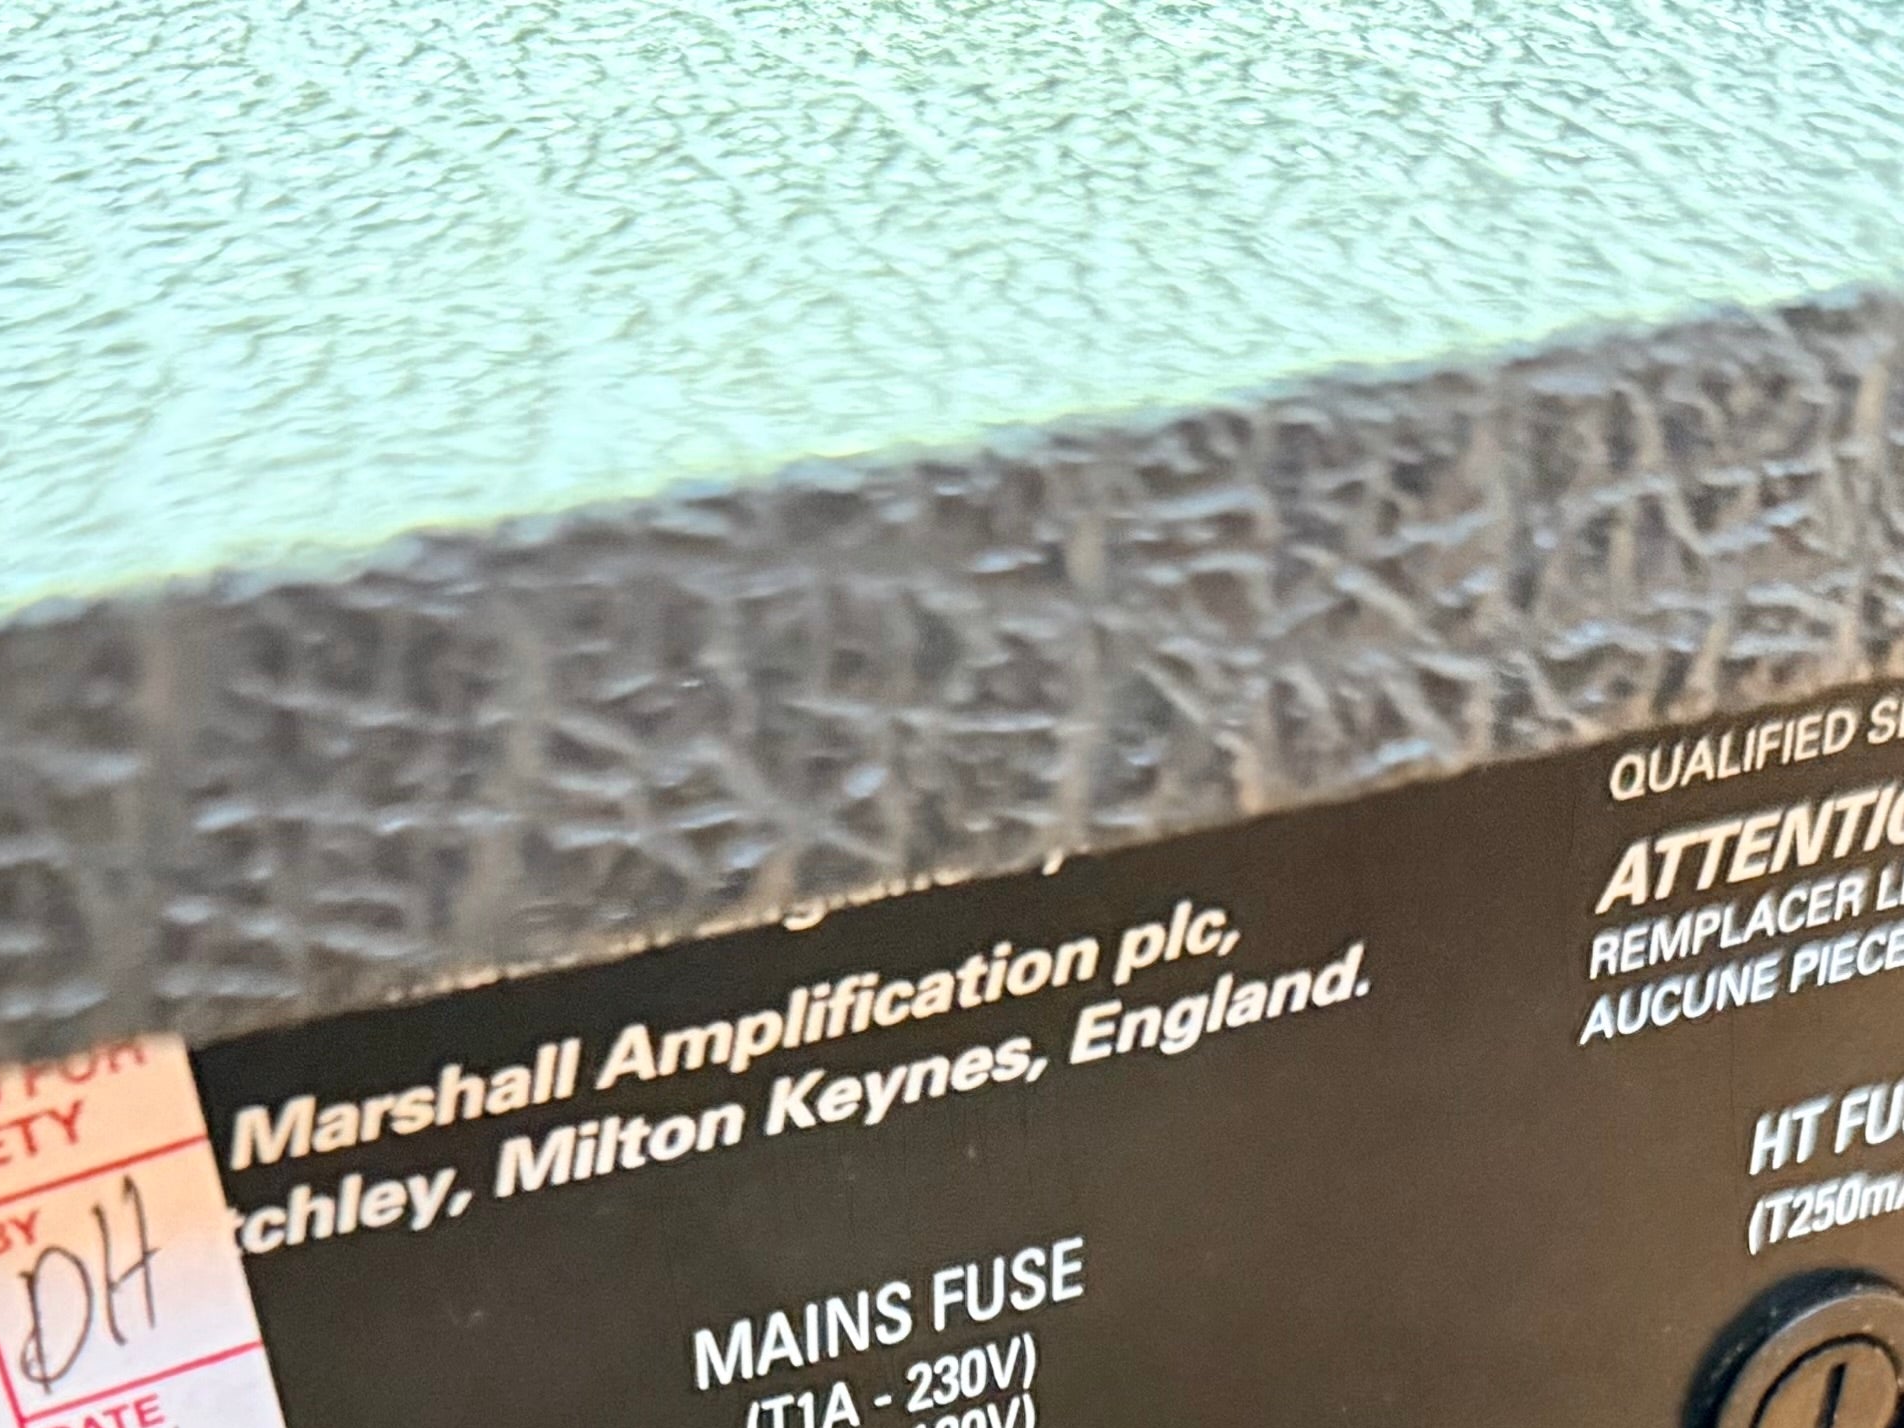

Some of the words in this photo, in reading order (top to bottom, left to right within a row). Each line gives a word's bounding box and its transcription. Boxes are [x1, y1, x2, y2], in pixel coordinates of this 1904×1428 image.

[1609, 708, 1860, 801] QUALIFIED
[1588, 869, 1871, 980] REMPLACER
[228, 1036, 584, 1173] Marshall
[593, 935, 1102, 1091] Amplification
[1111, 897, 1243, 988] plc,
[1577, 949, 1788, 1047] AUCUNE
[495, 1102, 746, 1199] Milton
[764, 1033, 1049, 1136] Keynes,
[1068, 939, 1372, 1065] England.
[1748, 1094, 1837, 1177] HT
[693, 1280, 913, 1392] MAINS
[931, 1235, 1085, 1332] FUSE
[905, 1331, 1038, 1414] 230V)
